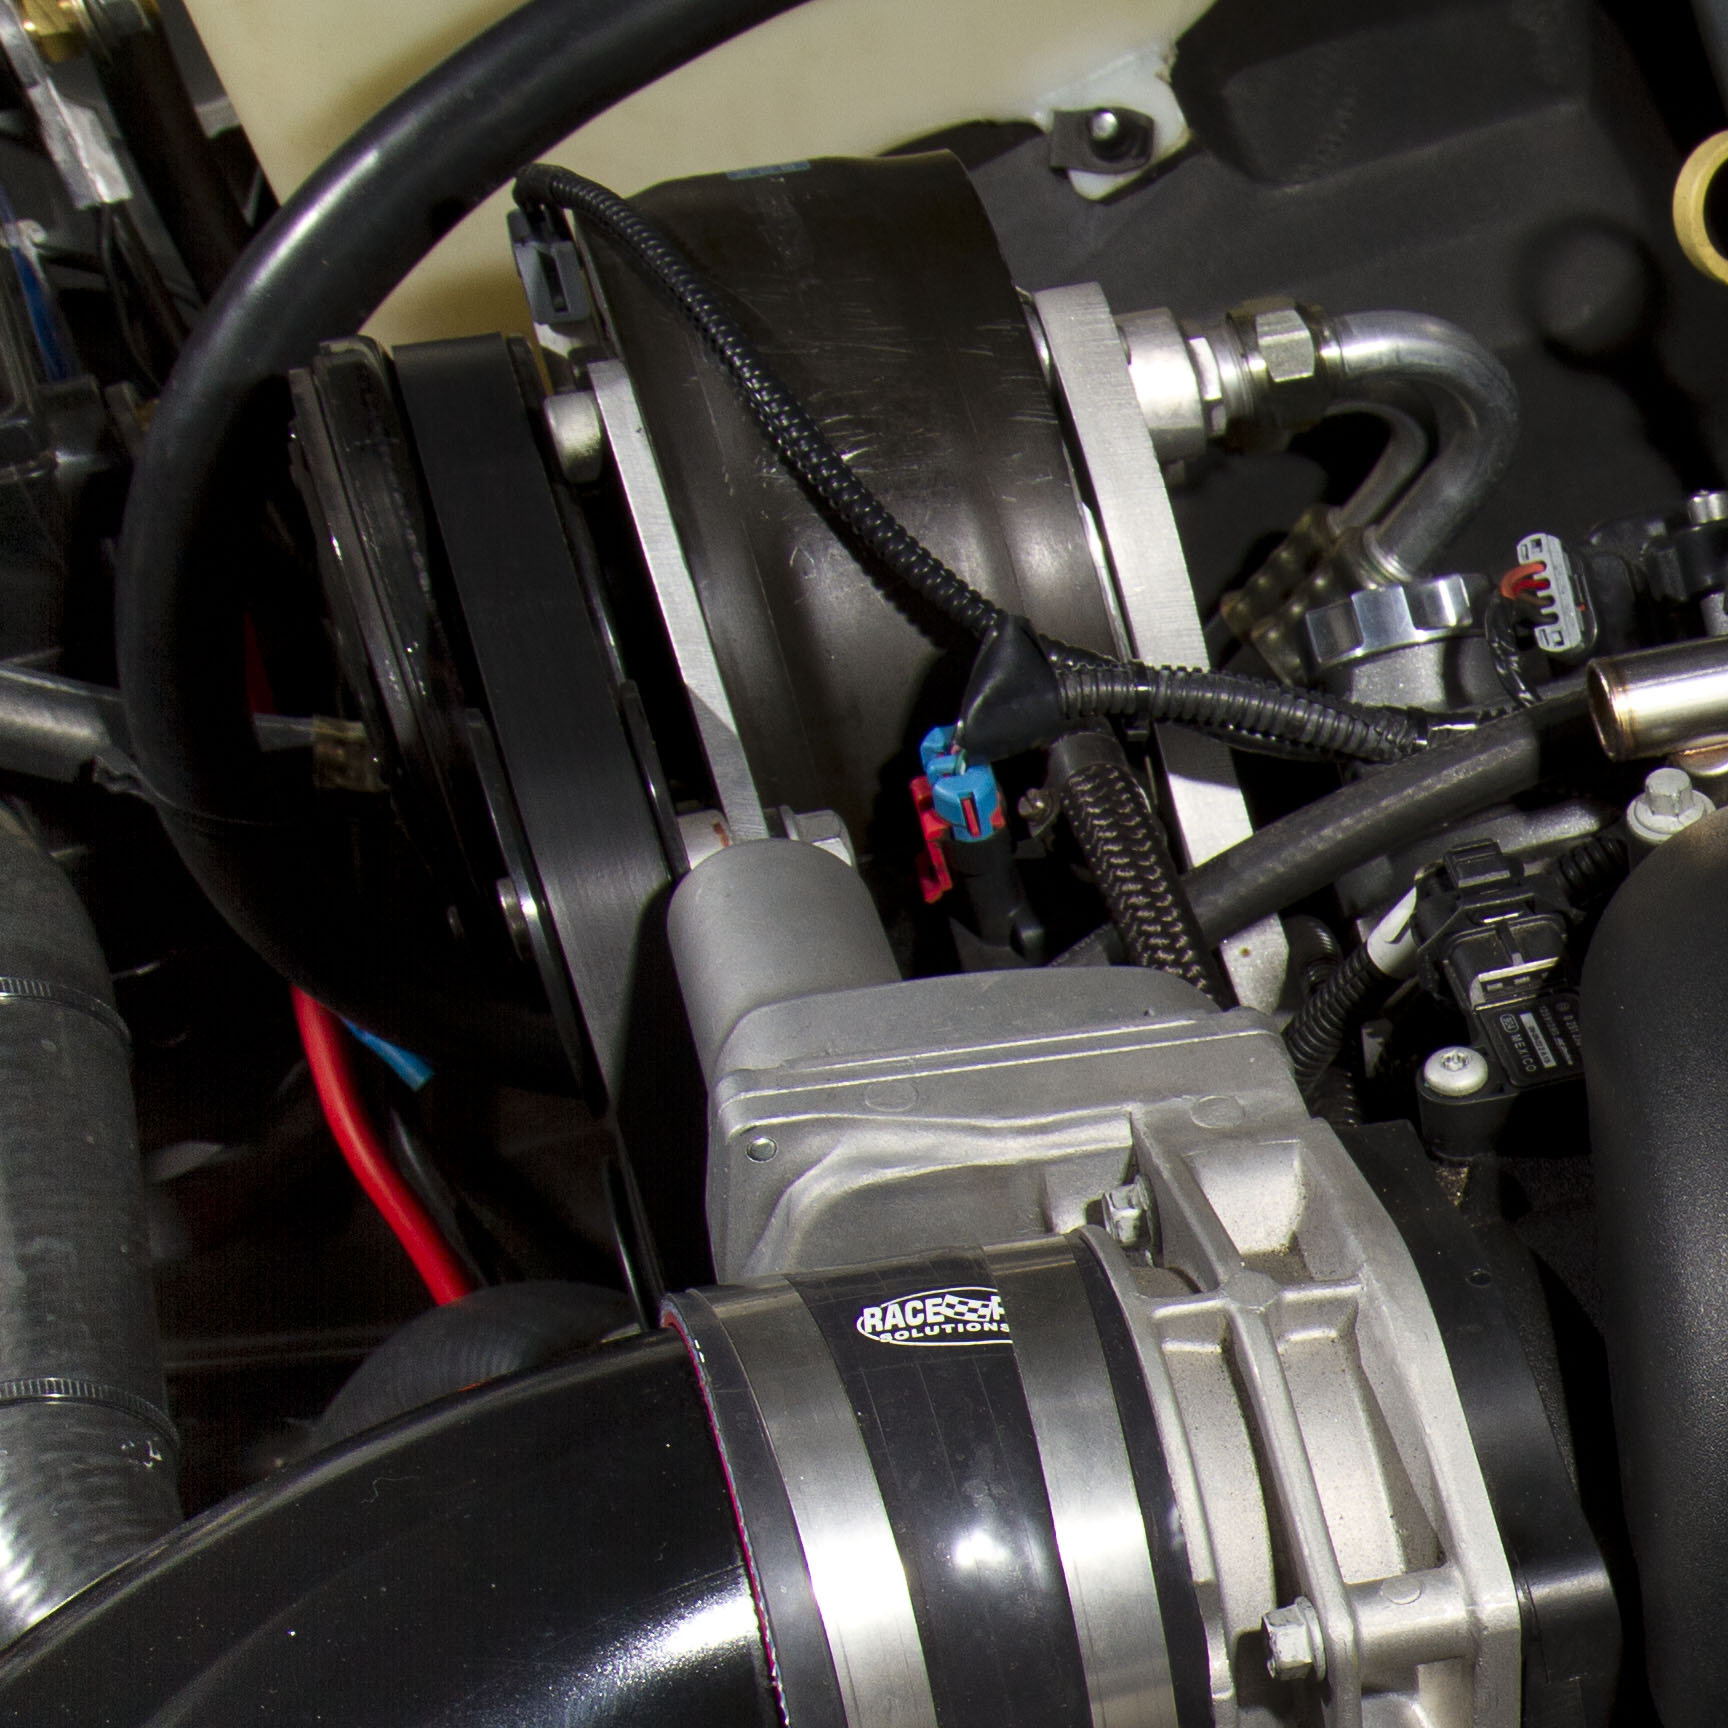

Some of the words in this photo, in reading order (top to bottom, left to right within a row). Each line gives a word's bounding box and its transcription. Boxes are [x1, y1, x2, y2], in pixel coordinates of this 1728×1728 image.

[1510, 1031, 1537, 1073] MEXICO
[863, 1297, 945, 1333] RACE
[879, 1322, 1009, 1343] SOLUTIONS
